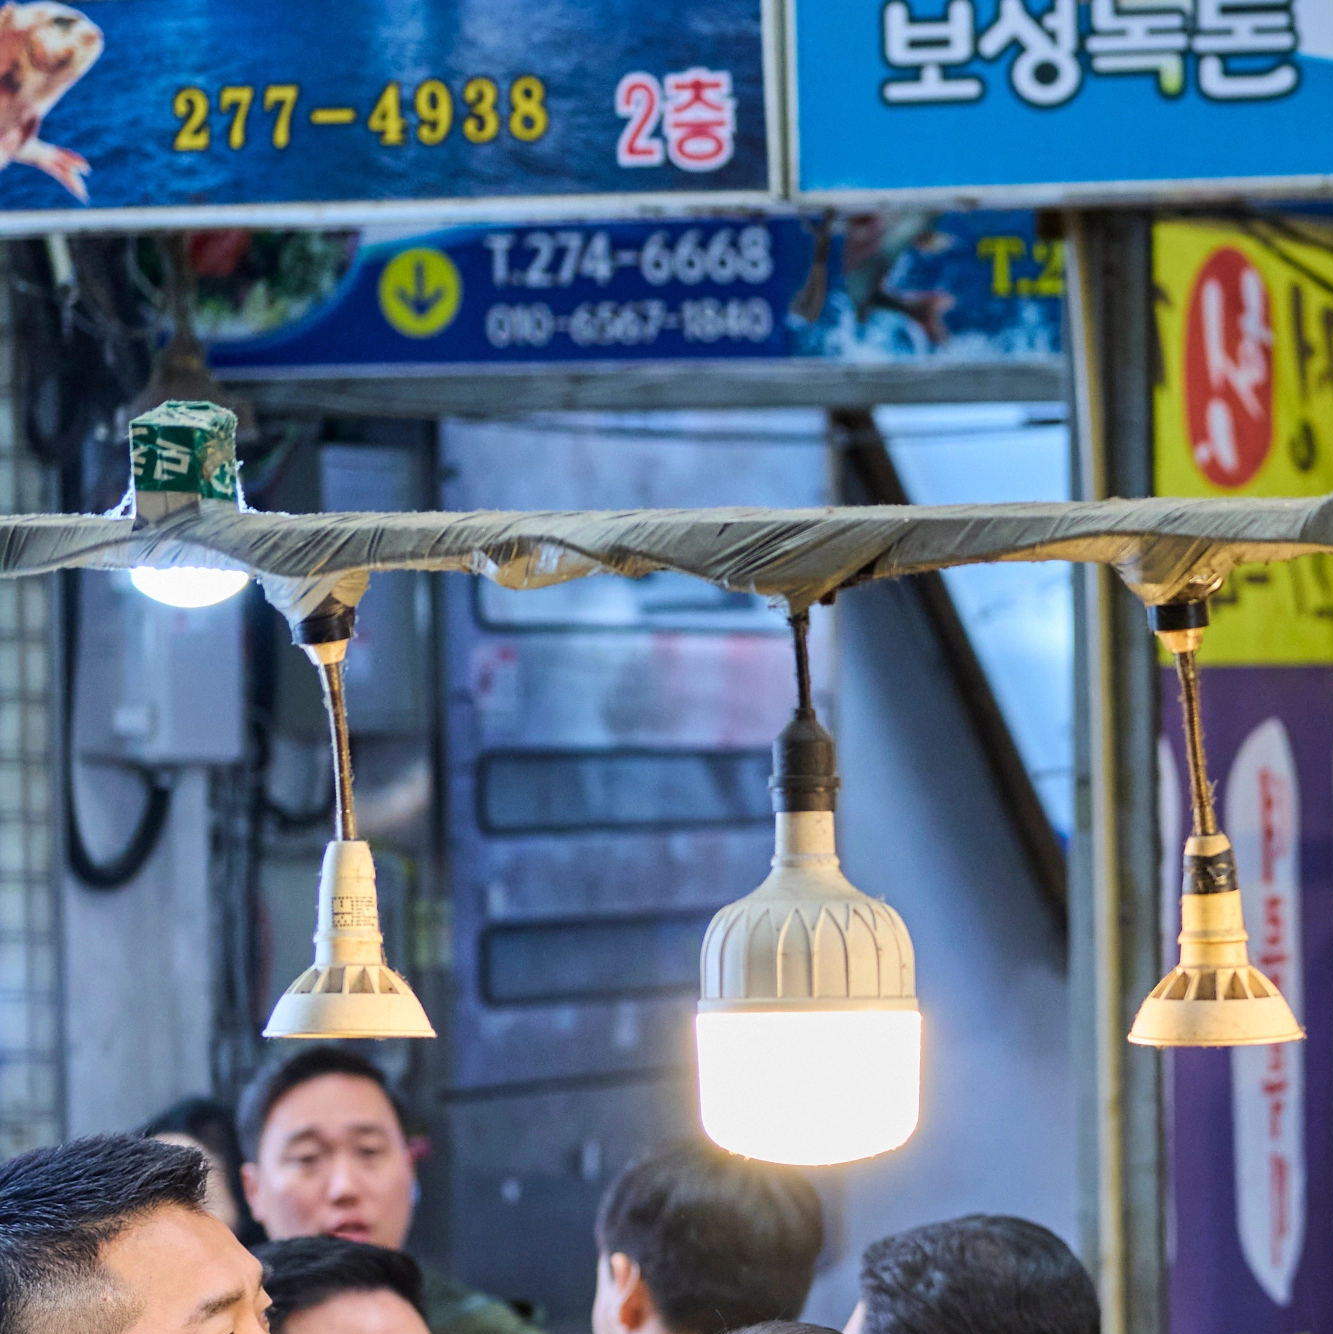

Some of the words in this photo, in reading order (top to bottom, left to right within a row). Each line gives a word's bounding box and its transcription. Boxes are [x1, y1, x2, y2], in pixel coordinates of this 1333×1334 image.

[173, 75, 549, 151] 277-4938
[615, 67, 738, 172] 2층
[485, 225, 775, 288] T.274-6668
